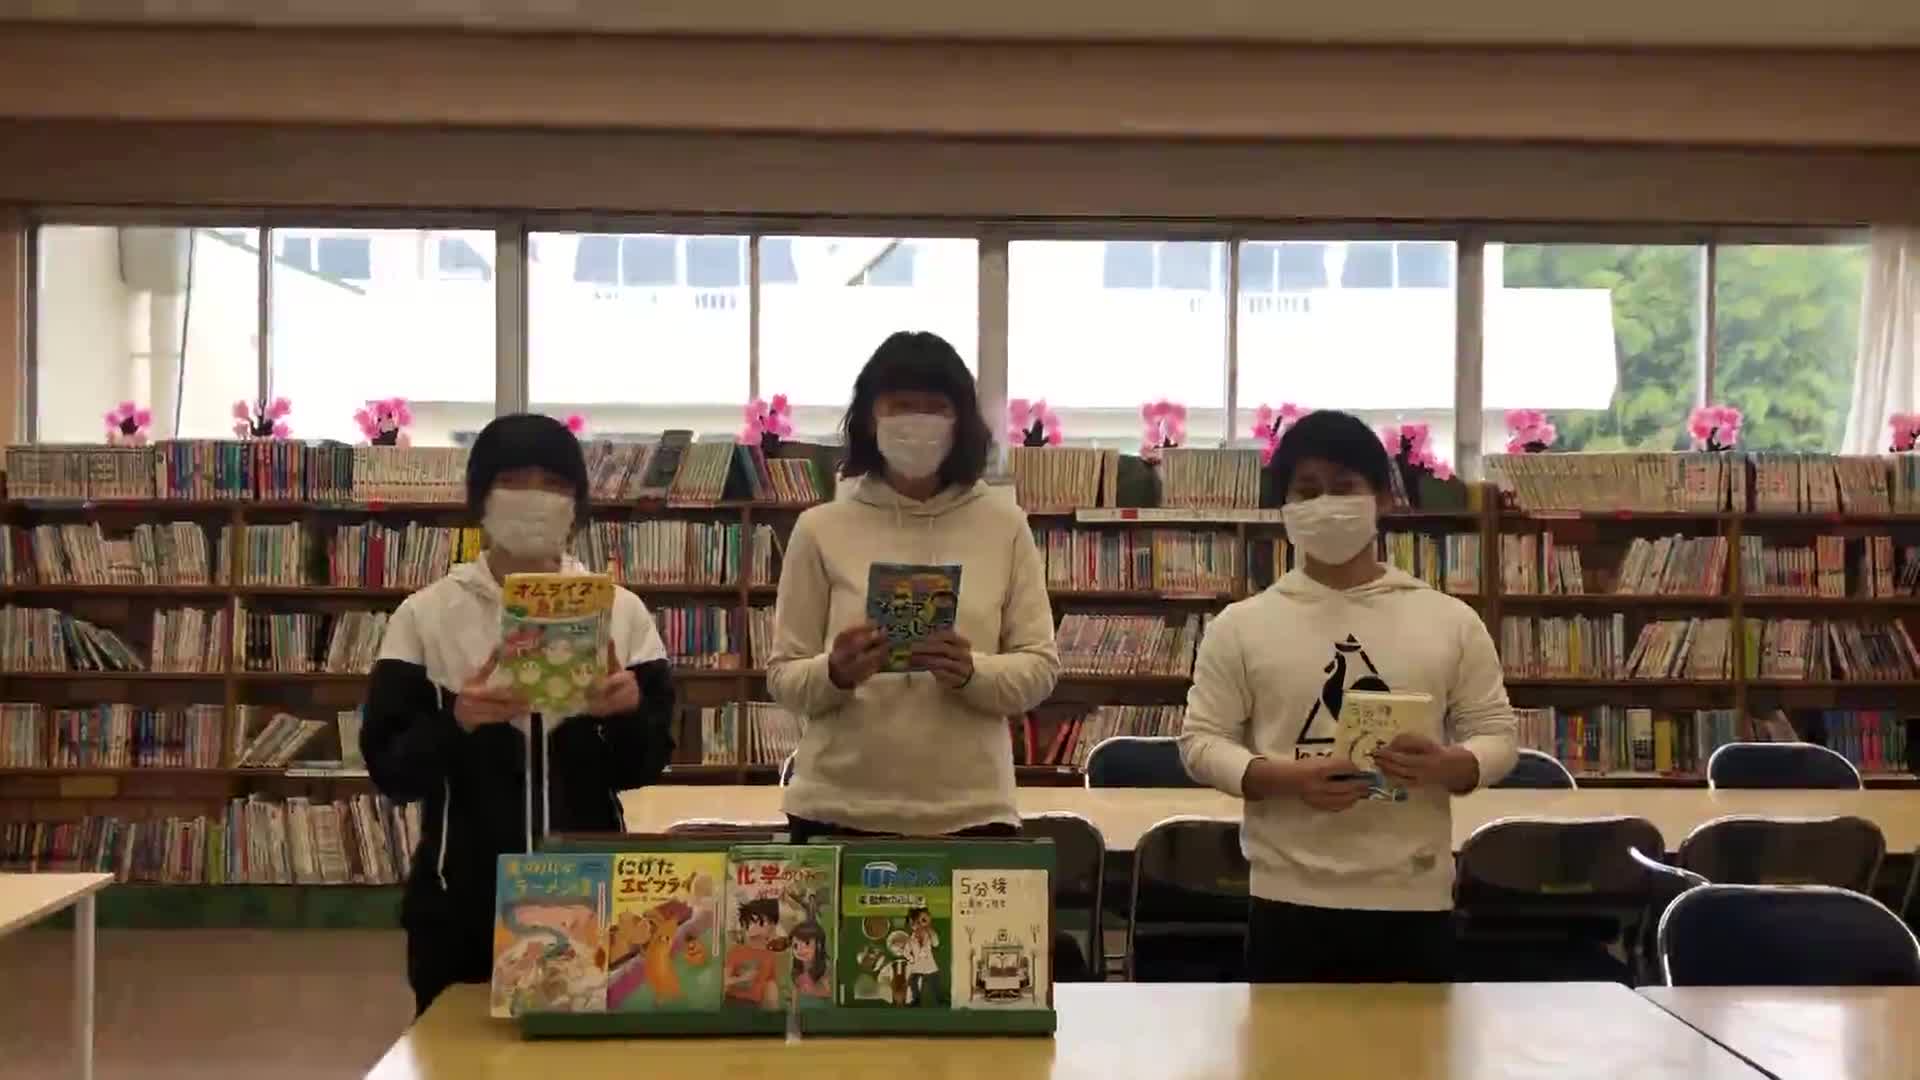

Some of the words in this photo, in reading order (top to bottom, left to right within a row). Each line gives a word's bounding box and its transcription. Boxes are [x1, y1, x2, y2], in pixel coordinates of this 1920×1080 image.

[616, 857, 674, 877] にげた
[619, 872, 698, 895] エビフライ
[960, 876, 1008, 897] 5分後
